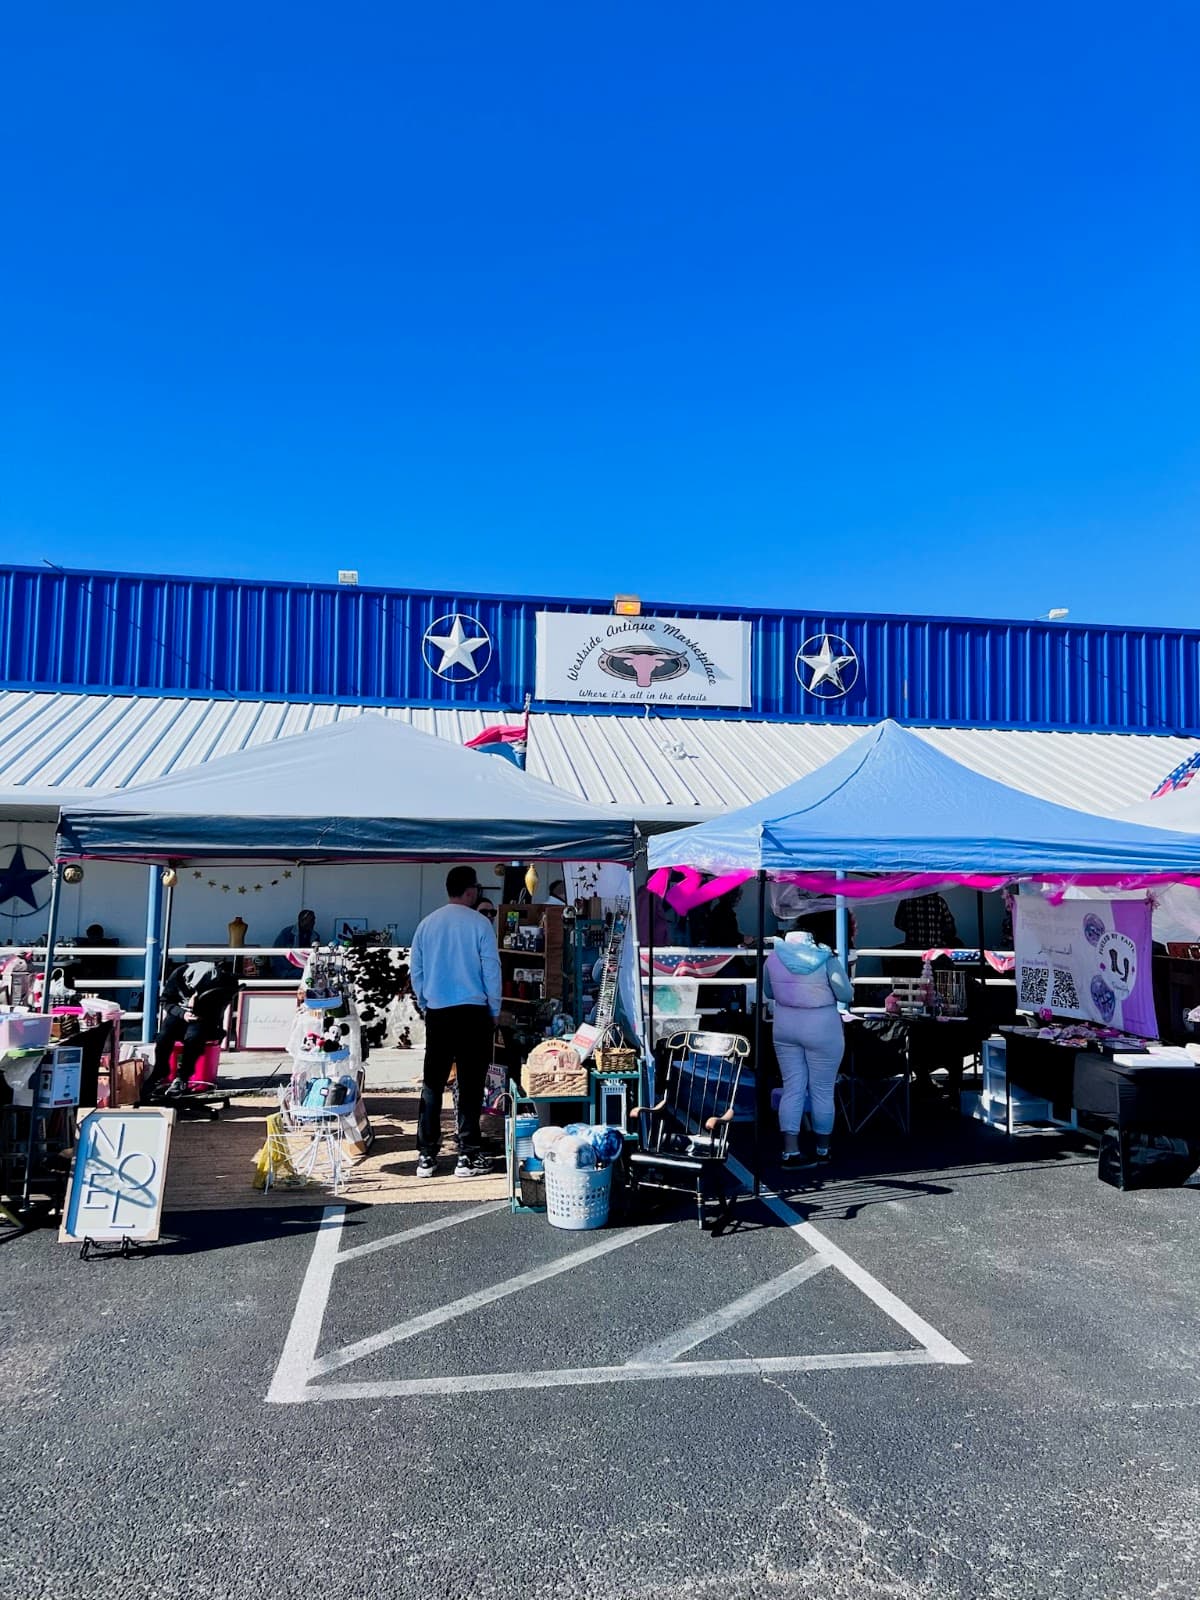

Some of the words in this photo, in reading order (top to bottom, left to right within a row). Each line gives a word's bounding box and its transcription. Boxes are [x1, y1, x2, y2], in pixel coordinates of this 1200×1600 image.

[567, 635, 603, 682] Westside
[606, 620, 656, 637] Antique
[663, 623, 717, 686] Marketplace
[578, 689, 608, 698] Where
[611, 690, 626, 699] it's
[629, 691, 643, 699] all
[659, 691, 673, 700] the
[676, 692, 707, 702] details
